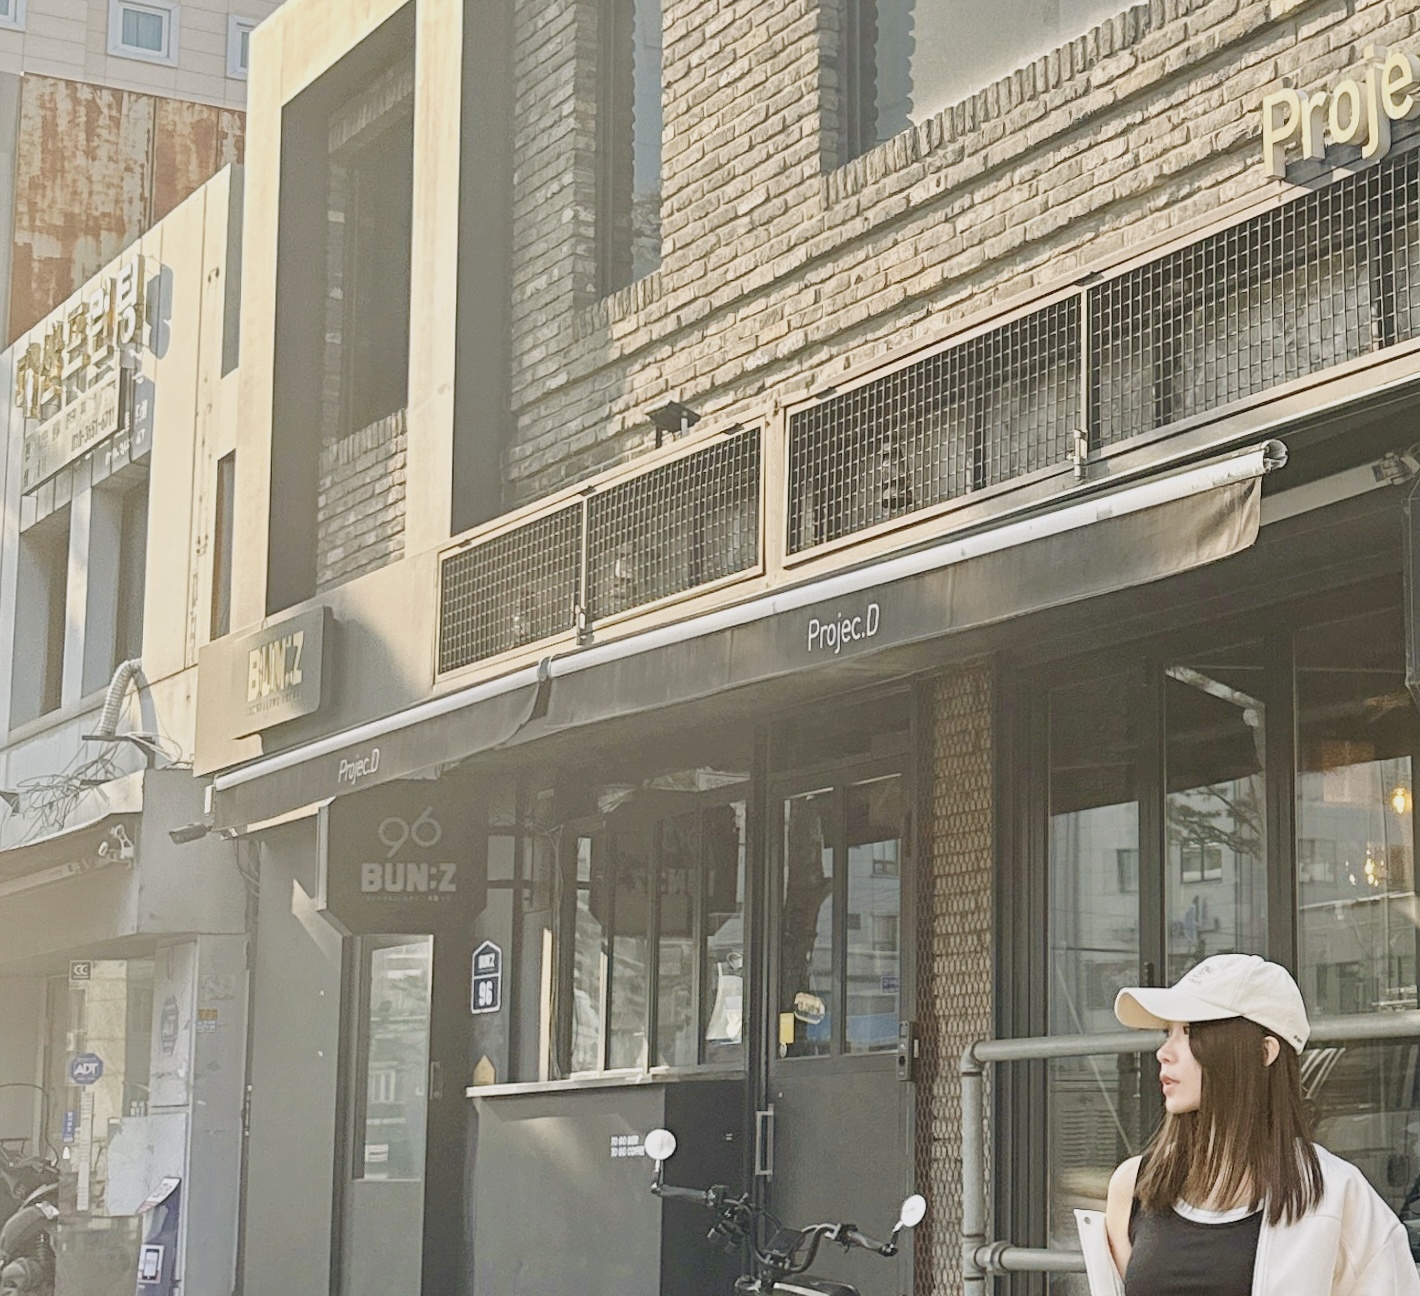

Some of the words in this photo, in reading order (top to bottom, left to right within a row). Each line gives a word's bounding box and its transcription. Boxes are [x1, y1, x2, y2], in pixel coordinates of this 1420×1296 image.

[808, 604, 880, 654] Projec.D
[338, 748, 380, 785] Projec.D
[378, 806, 442, 858] 96
[361, 863, 457, 892] BUN:Z
[478, 980, 493, 1006] 96
[74, 1063, 98, 1075] ADT
